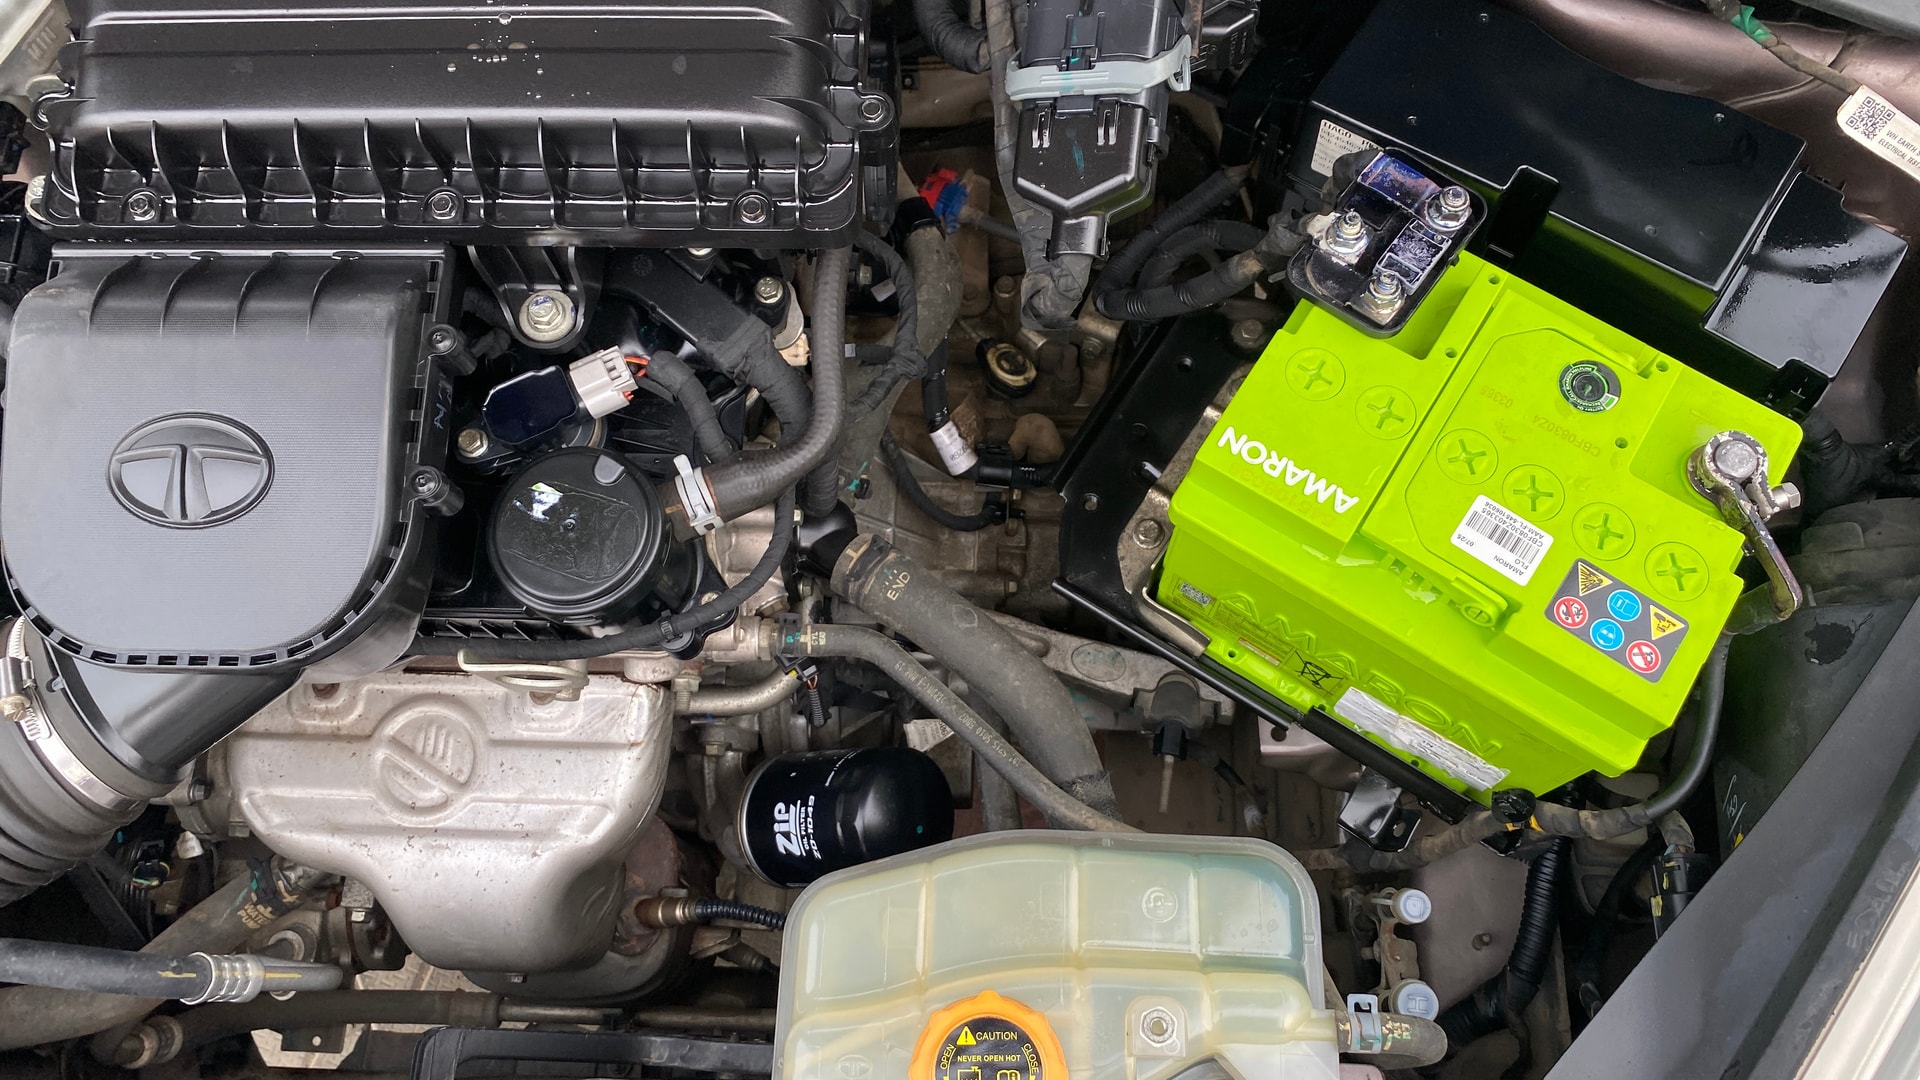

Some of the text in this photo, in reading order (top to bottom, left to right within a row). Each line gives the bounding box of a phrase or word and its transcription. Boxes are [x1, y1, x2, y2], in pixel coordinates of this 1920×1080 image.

[1878, 138, 1907, 160] ELECTRICAL
[1897, 137, 1918, 153] EARTH
[1480, 384, 1513, 409] 03365
[1217, 426, 1359, 513] AMARON
[1481, 507, 1544, 547] CBF0830Z403365
[1456, 533, 1525, 577] AMARON 07/25
[1513, 557, 1530, 570] FLO
[886, 571, 911, 600] END
[1220, 592, 1502, 758] AMARON
[1407, 994, 1429, 1015] H
[975, 1031, 1018, 1041] CAUTION
[940, 1042, 1039, 1074] OPEN CLOSE
[983, 1054, 1004, 1062] OPEN
[1005, 1054, 1021, 1062] HOT
